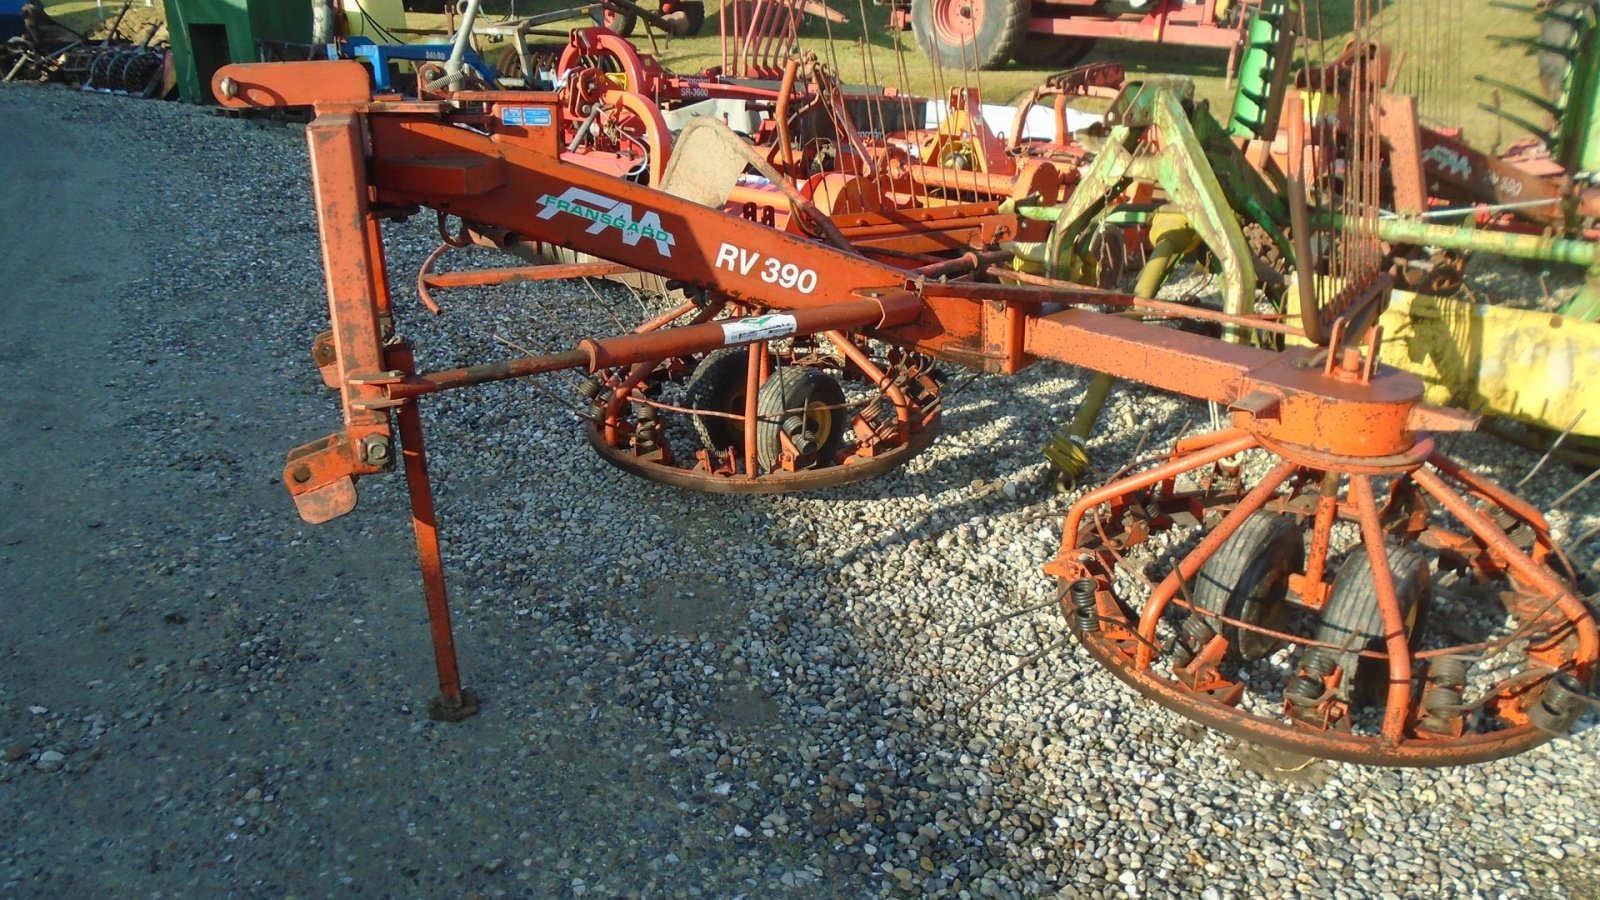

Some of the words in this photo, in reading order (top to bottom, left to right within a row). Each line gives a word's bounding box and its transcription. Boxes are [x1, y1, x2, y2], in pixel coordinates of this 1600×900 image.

[545, 195, 669, 242] FRANSGARD
[714, 243, 759, 276] RV
[760, 258, 818, 294] 390
